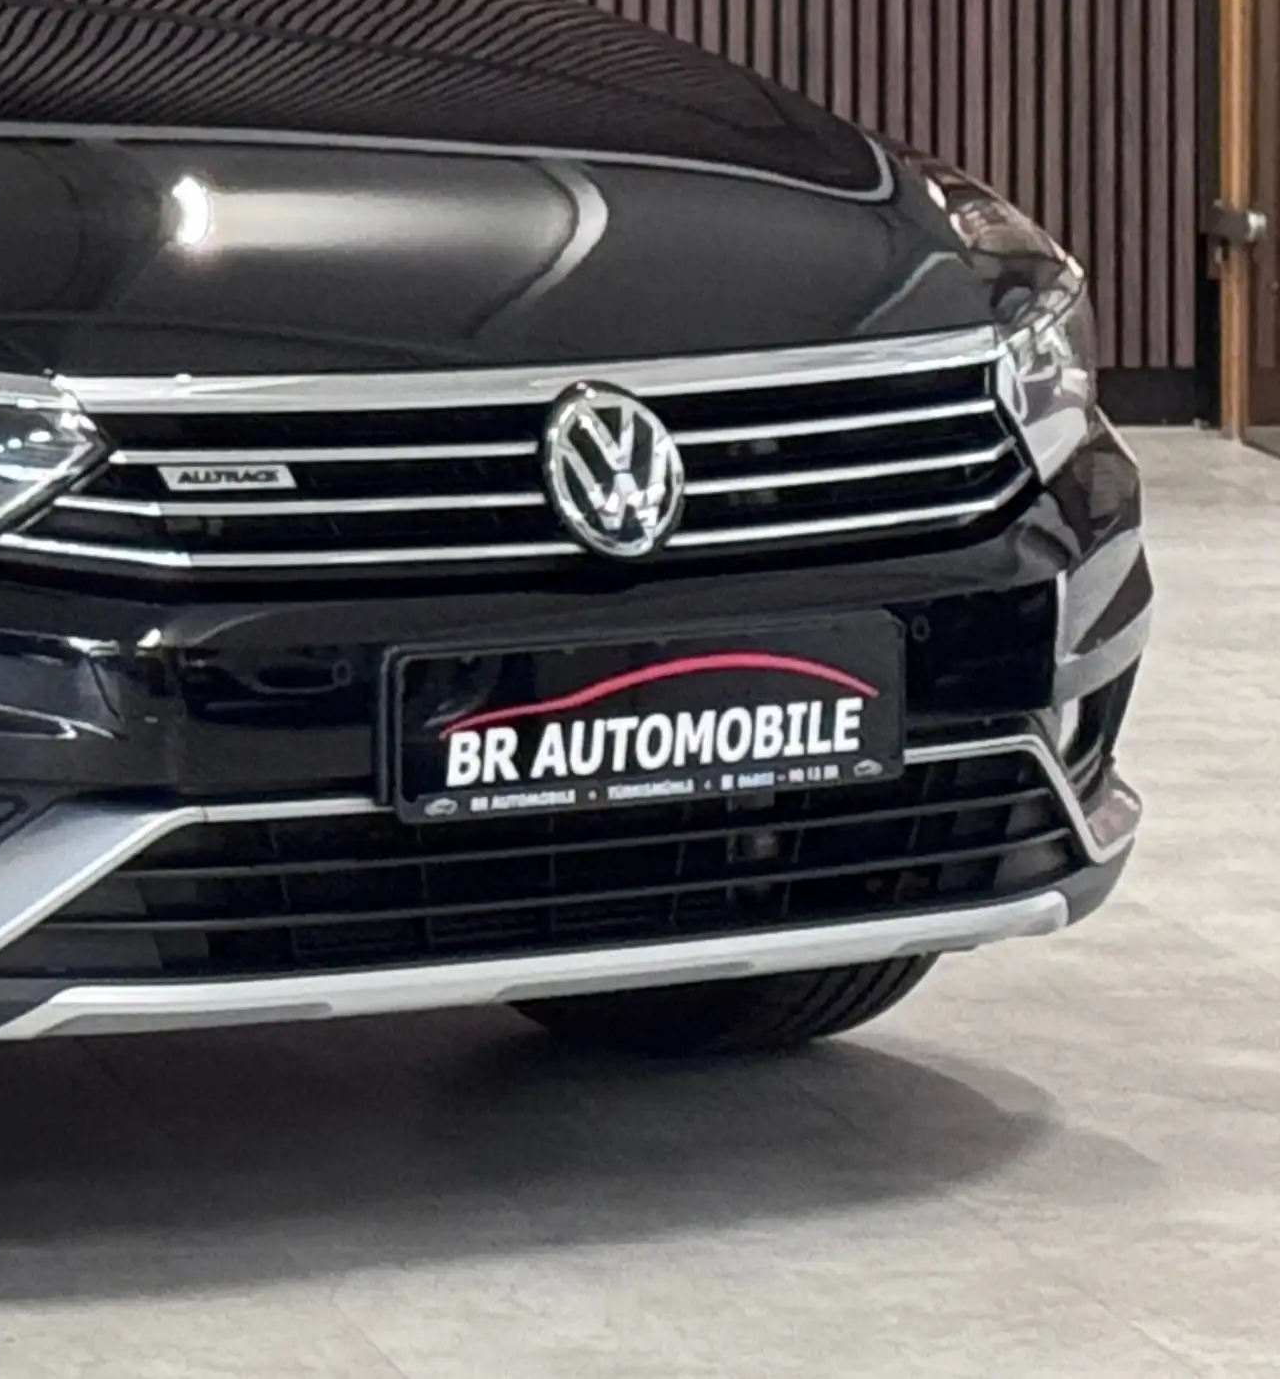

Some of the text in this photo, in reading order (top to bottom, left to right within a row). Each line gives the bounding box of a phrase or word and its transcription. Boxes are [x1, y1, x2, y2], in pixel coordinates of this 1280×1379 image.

[178, 470, 277, 484] ALLTRACK
[446, 697, 863, 787] BR AUTOMOBILE
